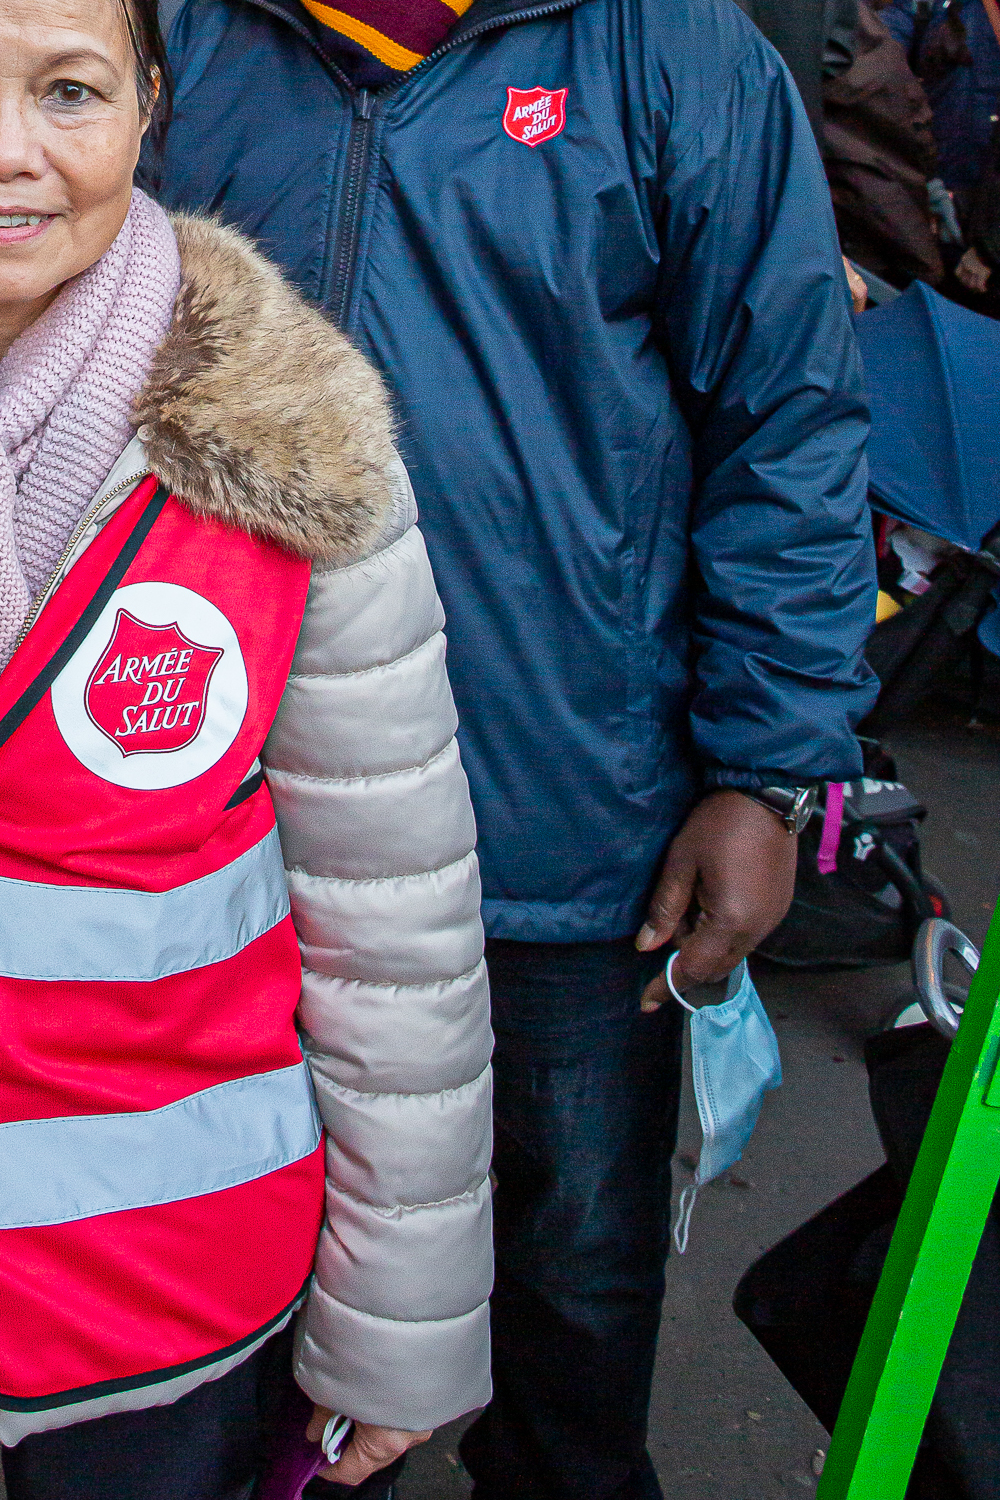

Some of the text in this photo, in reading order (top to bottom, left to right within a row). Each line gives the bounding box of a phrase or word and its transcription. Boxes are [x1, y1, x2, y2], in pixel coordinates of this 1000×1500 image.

[512, 95, 552, 122] ARMÉE
[532, 107, 550, 125] DU
[521, 114, 557, 141] SALUT
[94, 648, 193, 685] ARMÉE
[139, 677, 186, 706] DU
[115, 701, 199, 737] SALUT
